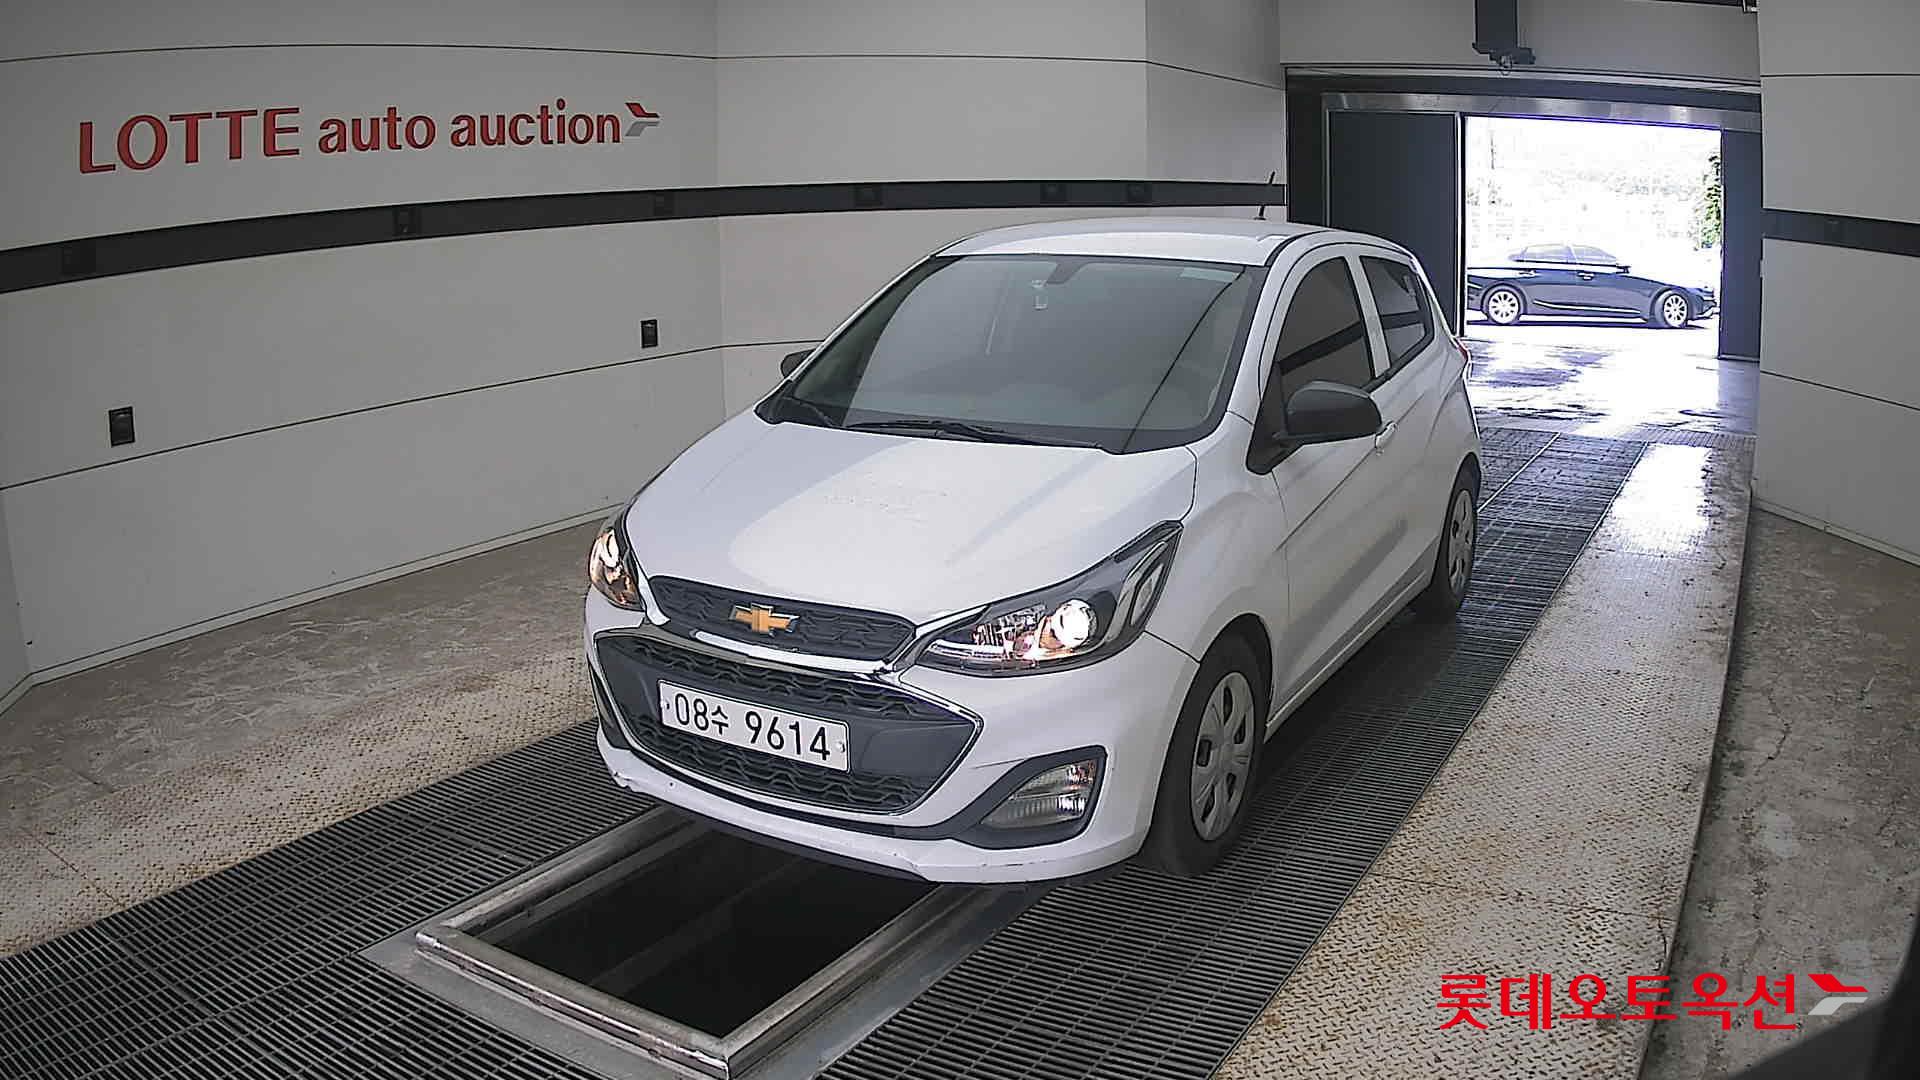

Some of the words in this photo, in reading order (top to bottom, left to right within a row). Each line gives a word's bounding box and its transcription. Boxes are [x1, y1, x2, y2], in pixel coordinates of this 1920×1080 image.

[79, 106, 301, 174] LOTTE
[317, 106, 436, 154] auto
[450, 98, 621, 148] auction
[674, 692, 729, 735] 08수
[745, 711, 831, 761] 9614
